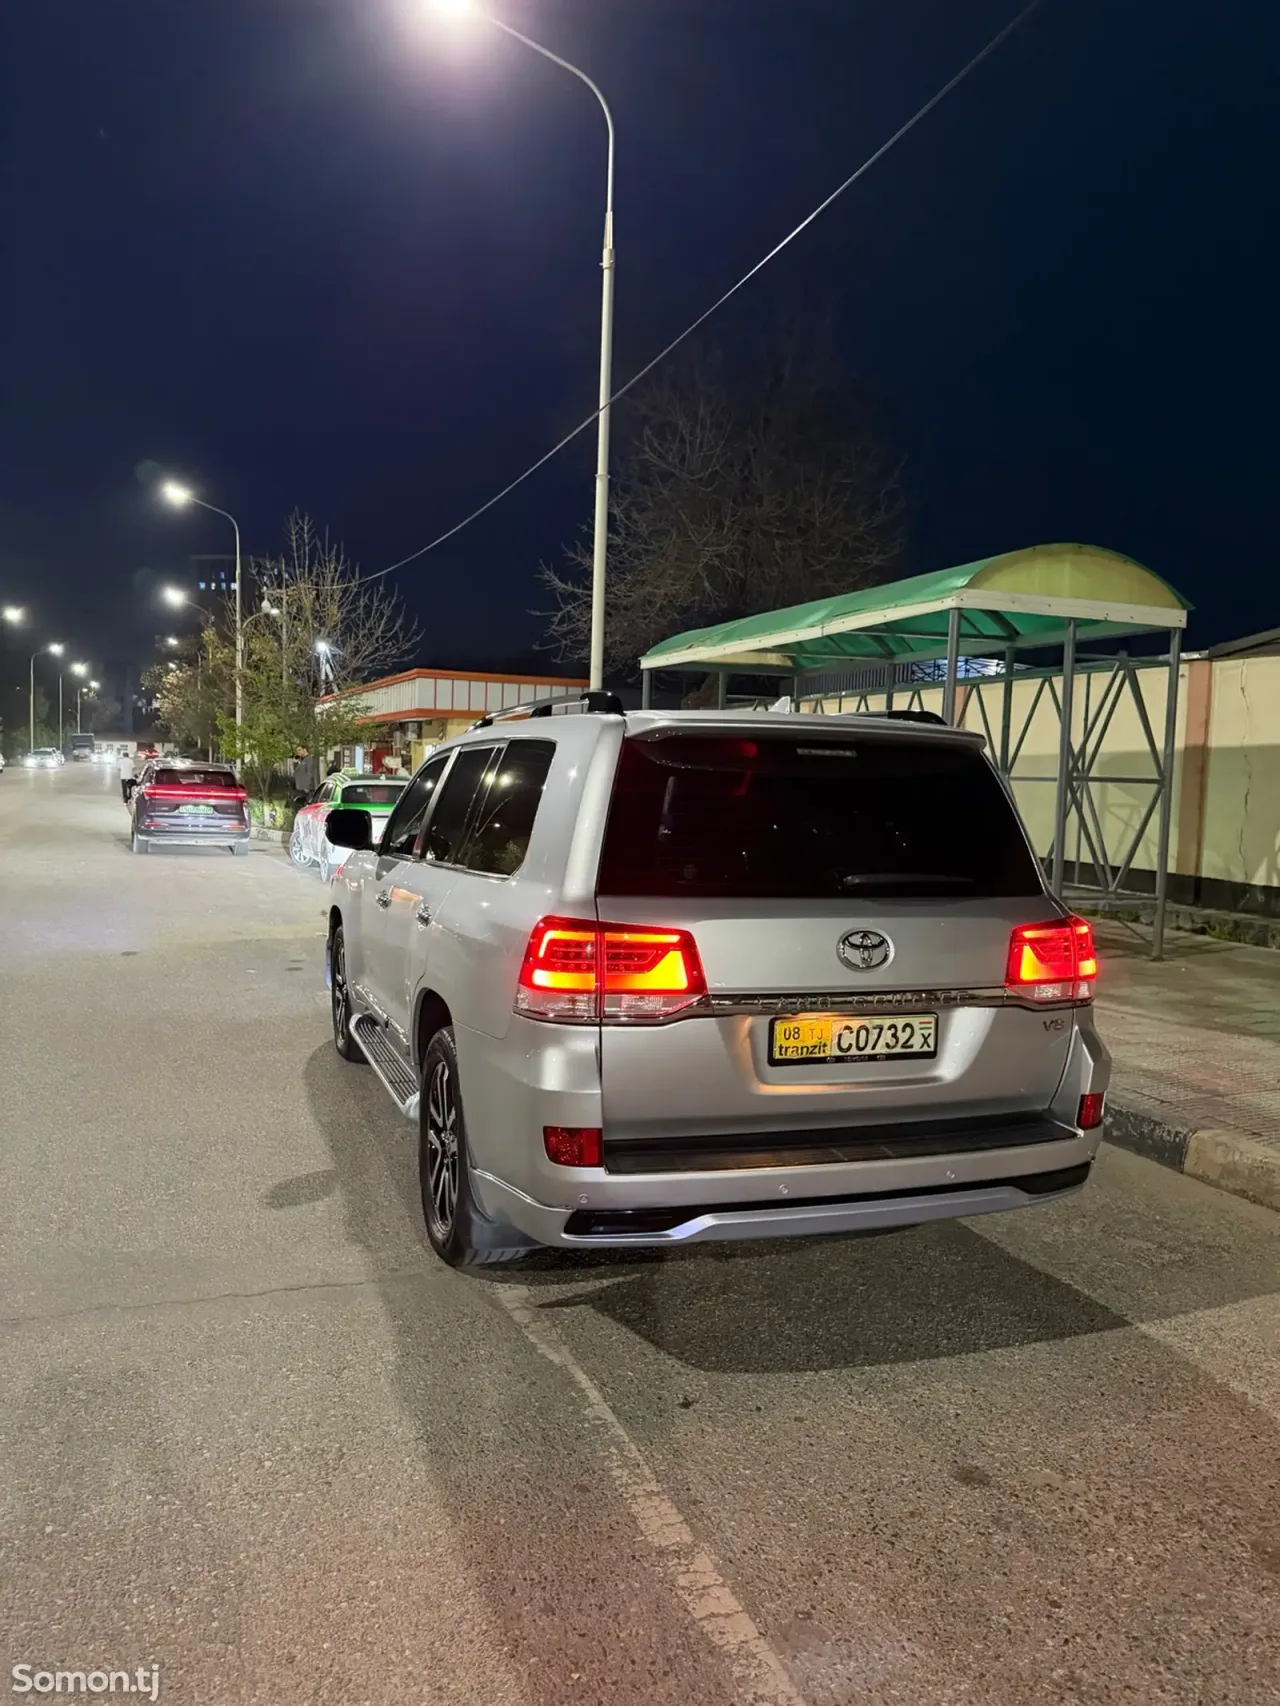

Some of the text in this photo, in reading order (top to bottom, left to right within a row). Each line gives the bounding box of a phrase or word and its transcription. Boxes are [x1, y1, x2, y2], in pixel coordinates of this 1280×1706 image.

[1042, 1018, 1065, 1032] V8
[783, 1026, 823, 1041] 08 TJ
[836, 1022, 915, 1054] C0732
[919, 1032, 932, 1049] X
[778, 1041, 828, 1057] tranzit
